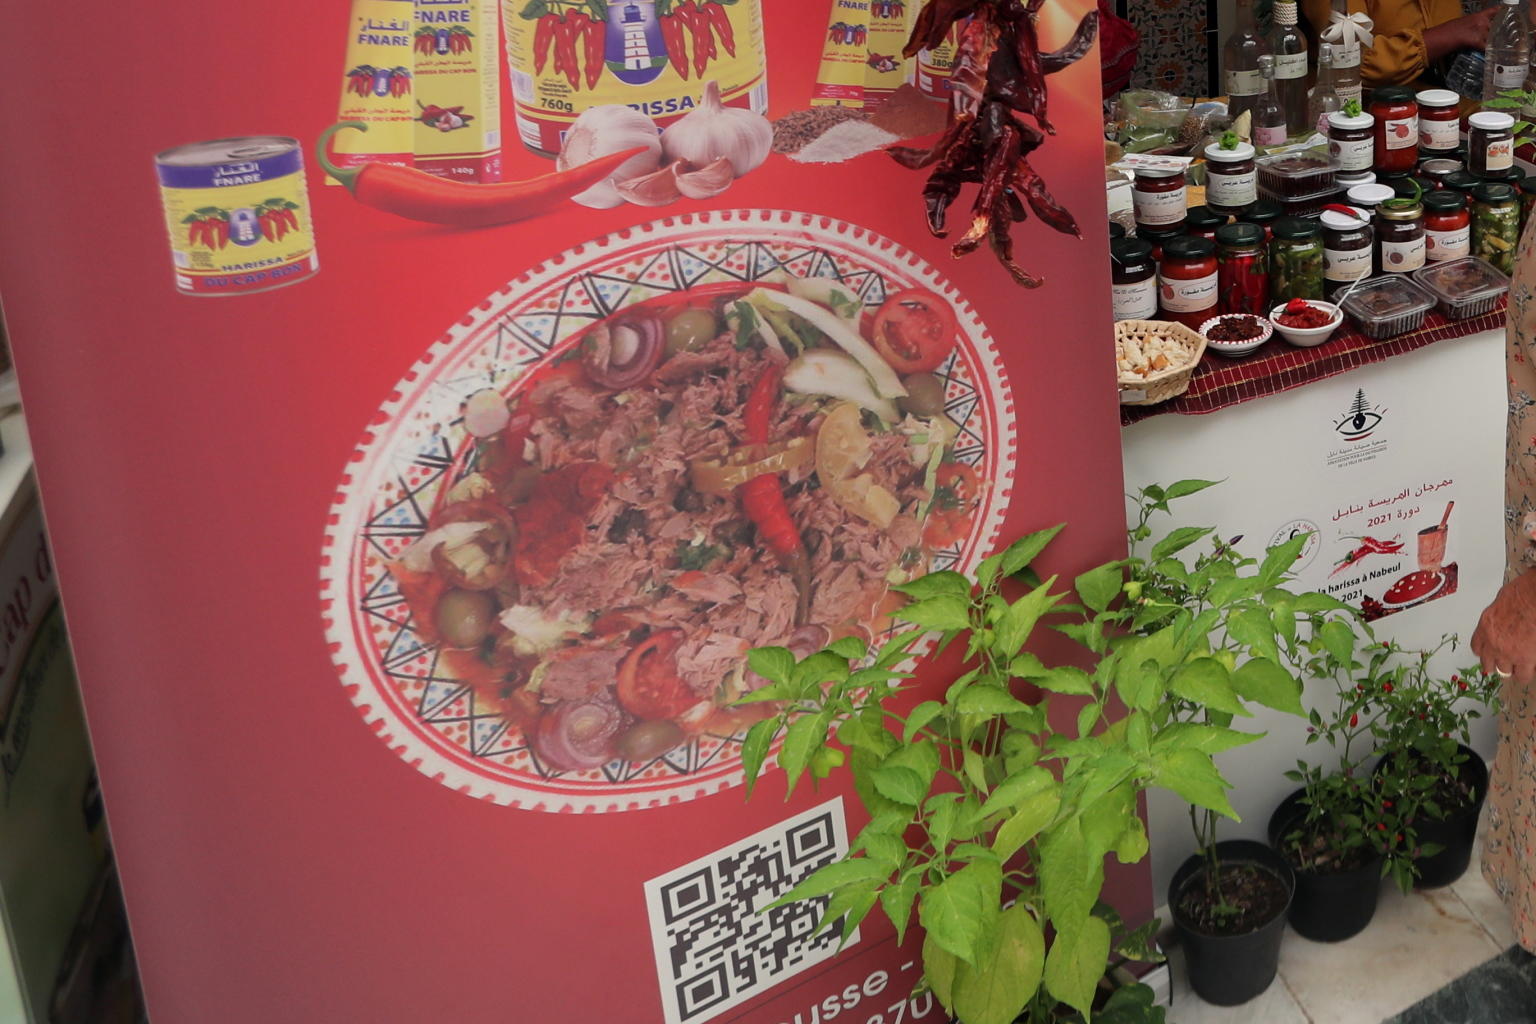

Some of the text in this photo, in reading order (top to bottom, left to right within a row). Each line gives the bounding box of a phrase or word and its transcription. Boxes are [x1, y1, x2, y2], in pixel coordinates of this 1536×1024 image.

[838, 0, 869, 11] FNARE
[358, 35, 408, 46] FNARE
[541, 98, 573, 112] 760g
[624, 95, 695, 115] ISSA
[213, 174, 261, 186] FNARE
[222, 257, 283, 272] HARISSA
[204, 264, 301, 287] DU CAP BON
[1367, 513, 1391, 527] 2021
[1328, 577, 1360, 594] harissa
[1369, 562, 1401, 581] Nabeul
[1342, 589, 1364, 603] 2021
[778, 970, 889, 1024] usse
